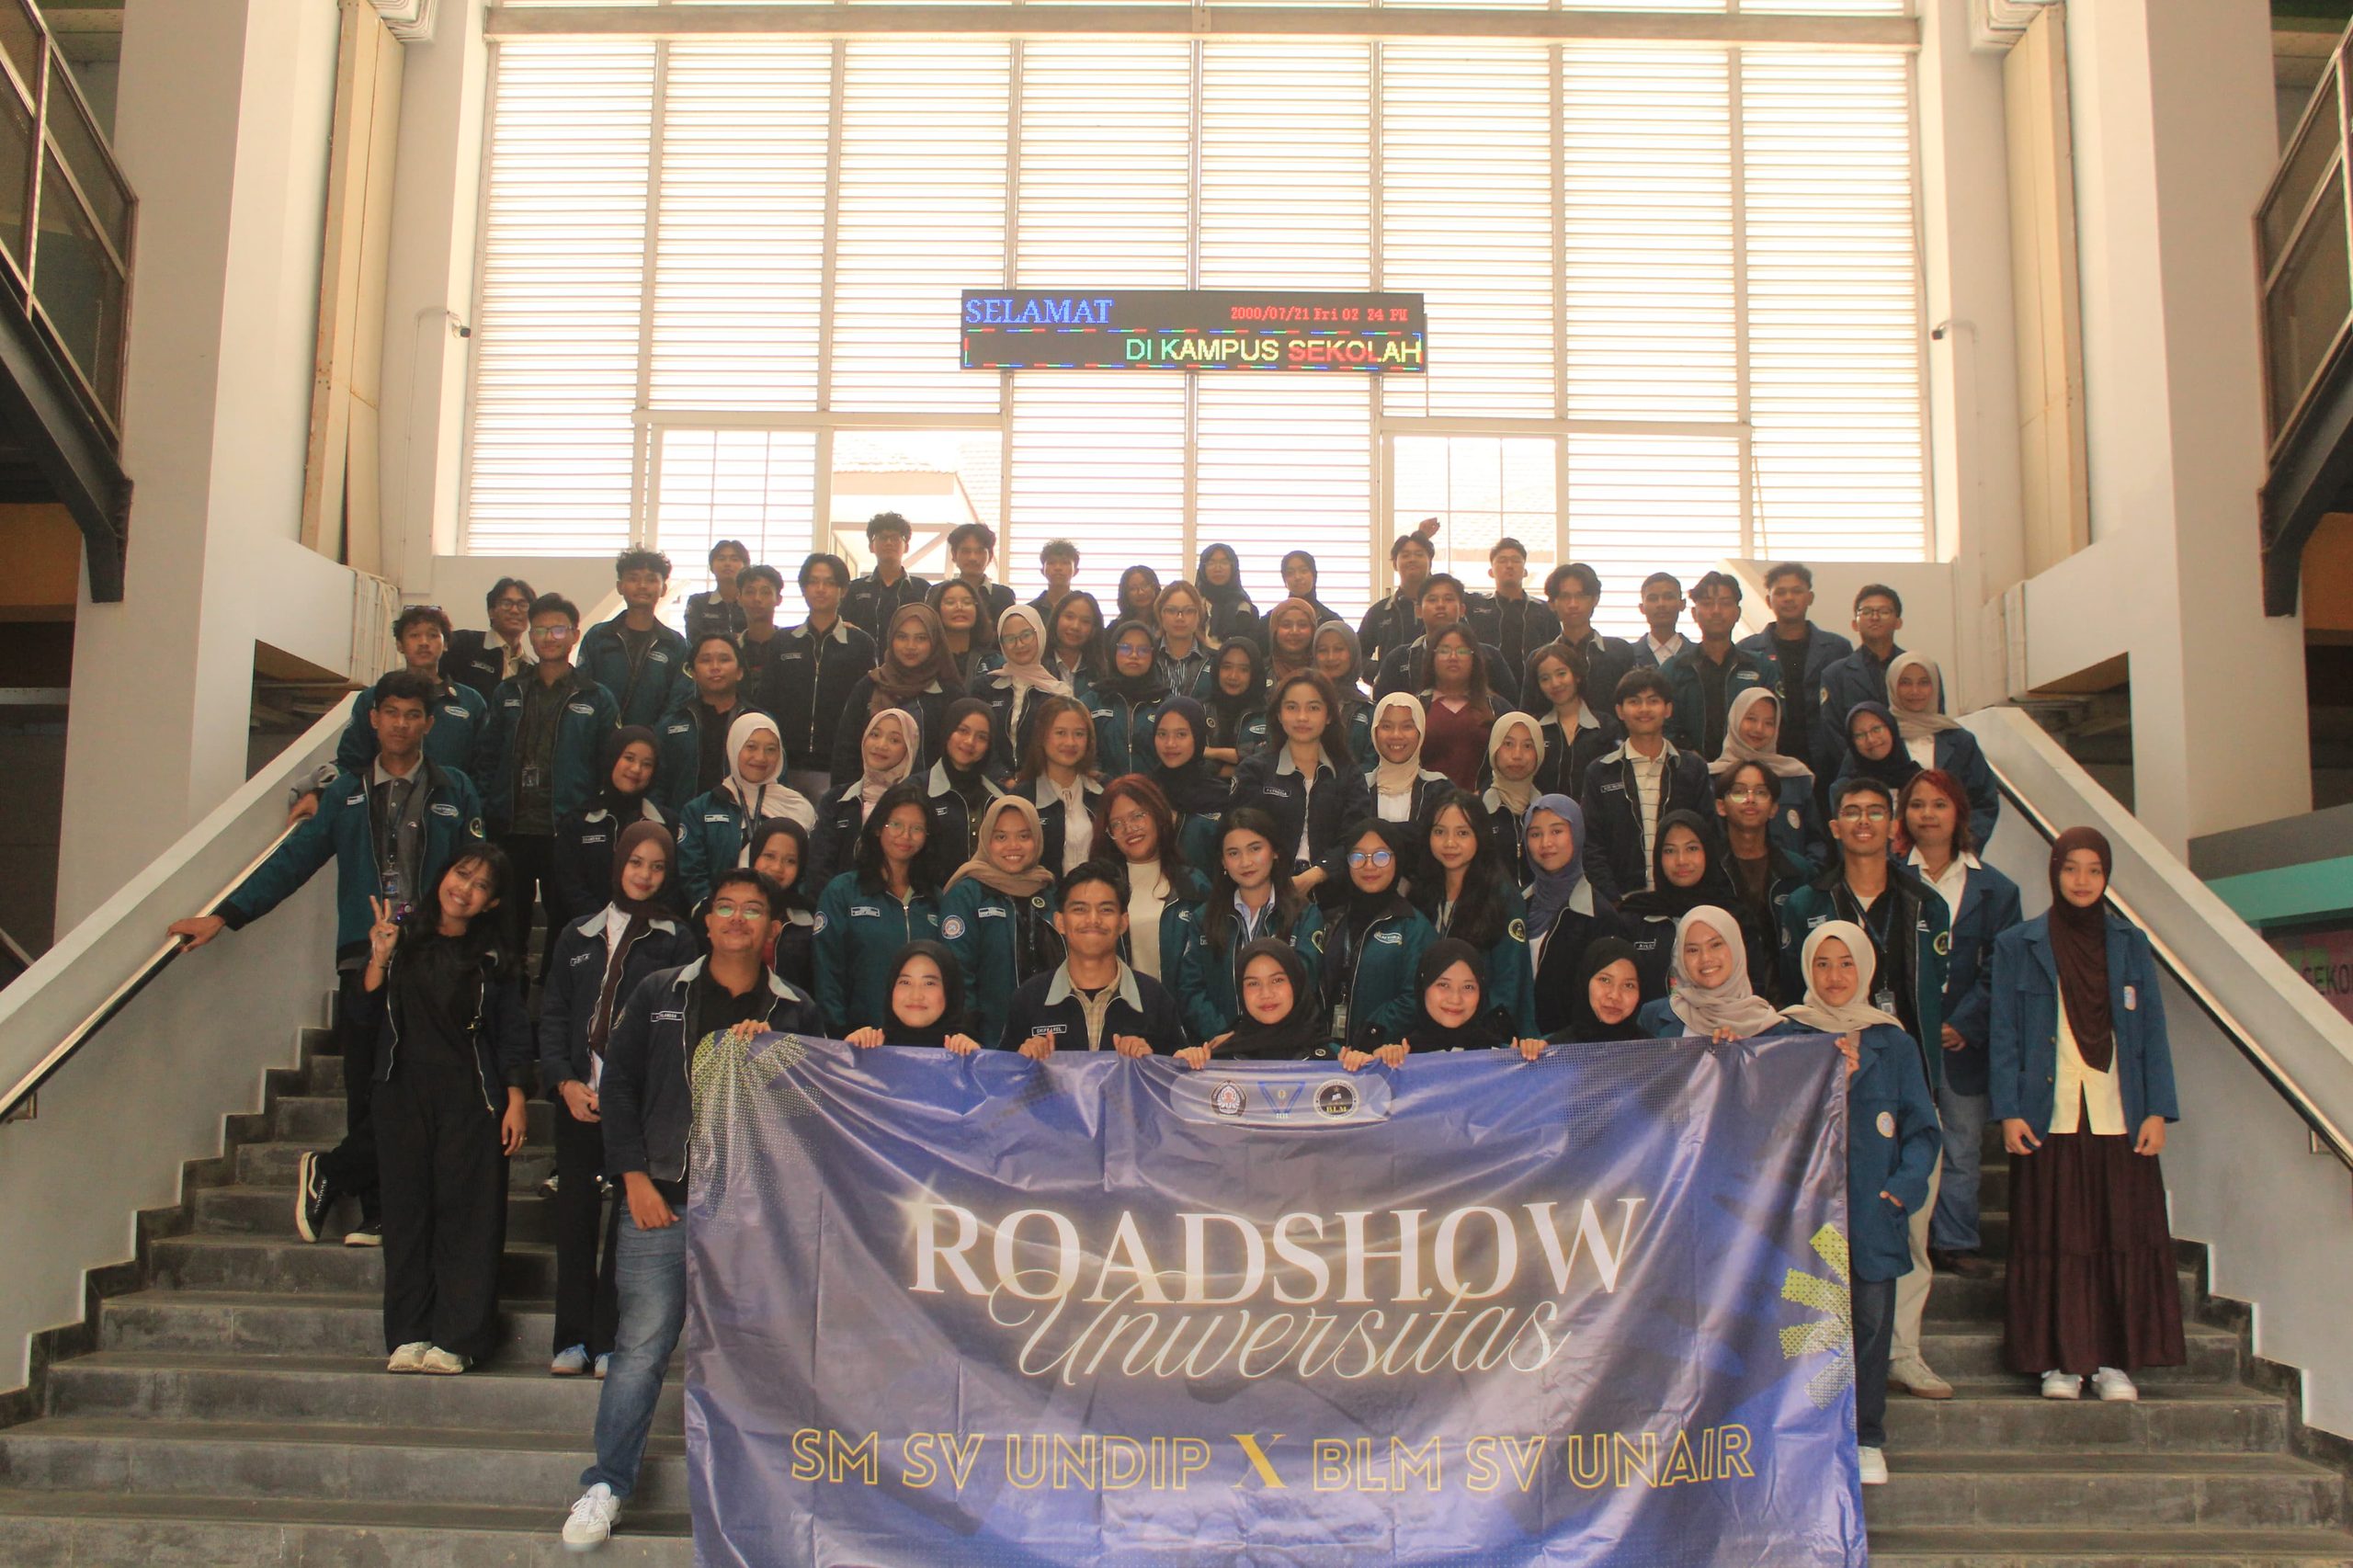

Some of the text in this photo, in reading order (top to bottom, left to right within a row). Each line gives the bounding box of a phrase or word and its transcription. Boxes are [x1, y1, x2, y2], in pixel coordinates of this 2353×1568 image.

[965, 299, 1114, 324] SELAMAT
[1230, 306, 1310, 321] 2000/07/21
[1313, 307, 1338, 321] Fri
[1367, 309, 1384, 322] 24
[1126, 338, 1422, 363] DI KAMPUS SEKOLAH
[908, 1198, 1646, 1305] ROADSHOW
[987, 1269, 1571, 1386] Universitas
[790, 1424, 1755, 1492] SM SV UNDIP X BLM SV UNAIR
